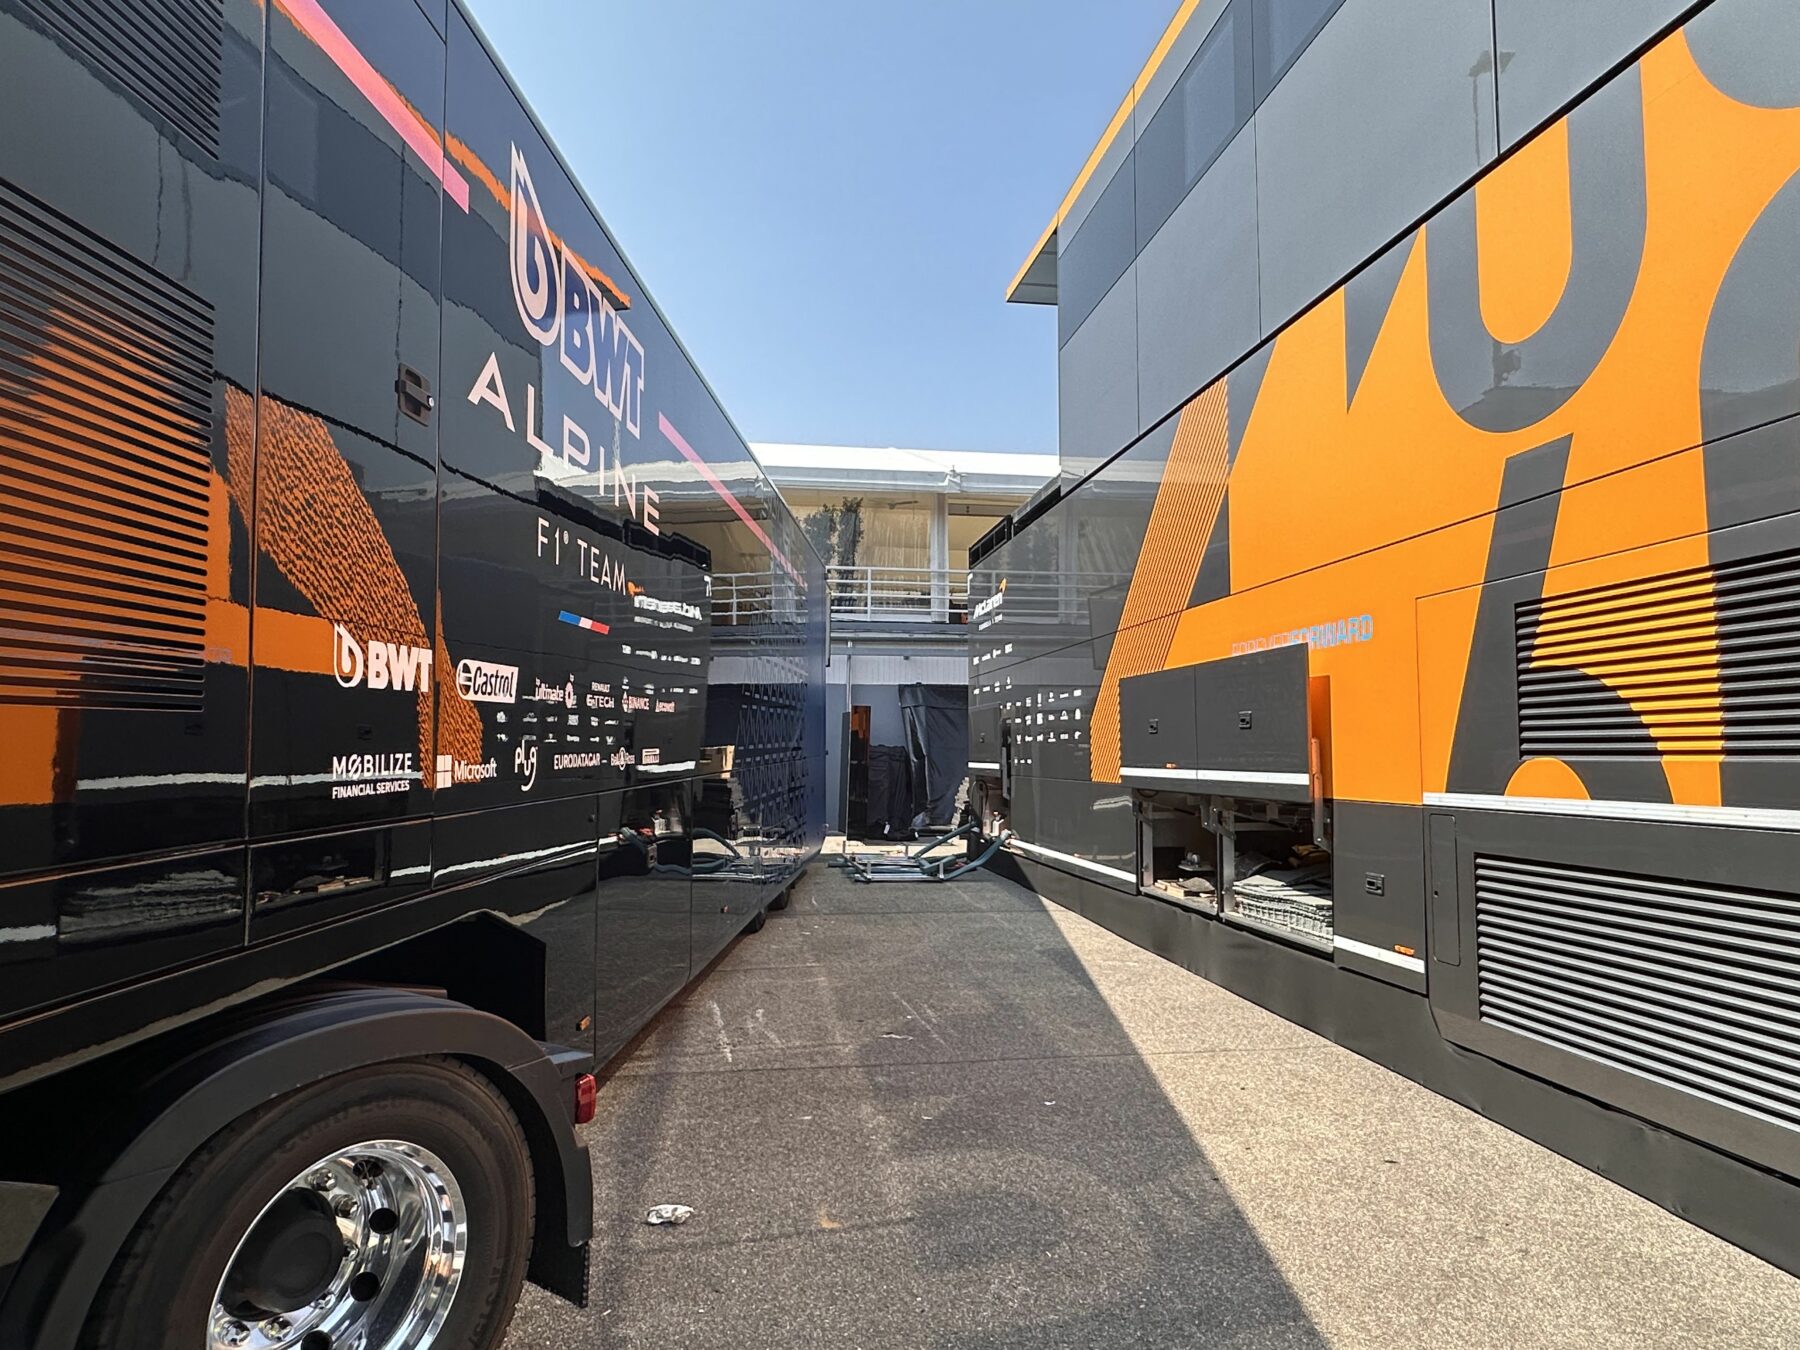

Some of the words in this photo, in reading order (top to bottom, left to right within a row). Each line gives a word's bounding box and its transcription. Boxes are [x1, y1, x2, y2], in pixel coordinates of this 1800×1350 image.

[560, 239, 645, 440] BWT
[467, 351, 660, 536] ALPINE
[577, 537, 627, 595] TEAM
[367, 640, 433, 693] BWT
[472, 666, 515, 698] Castrol
[332, 782, 376, 799] FINANCIAL
[376, 780, 410, 796] SERVICES
[454, 757, 497, 781] Microsoft
